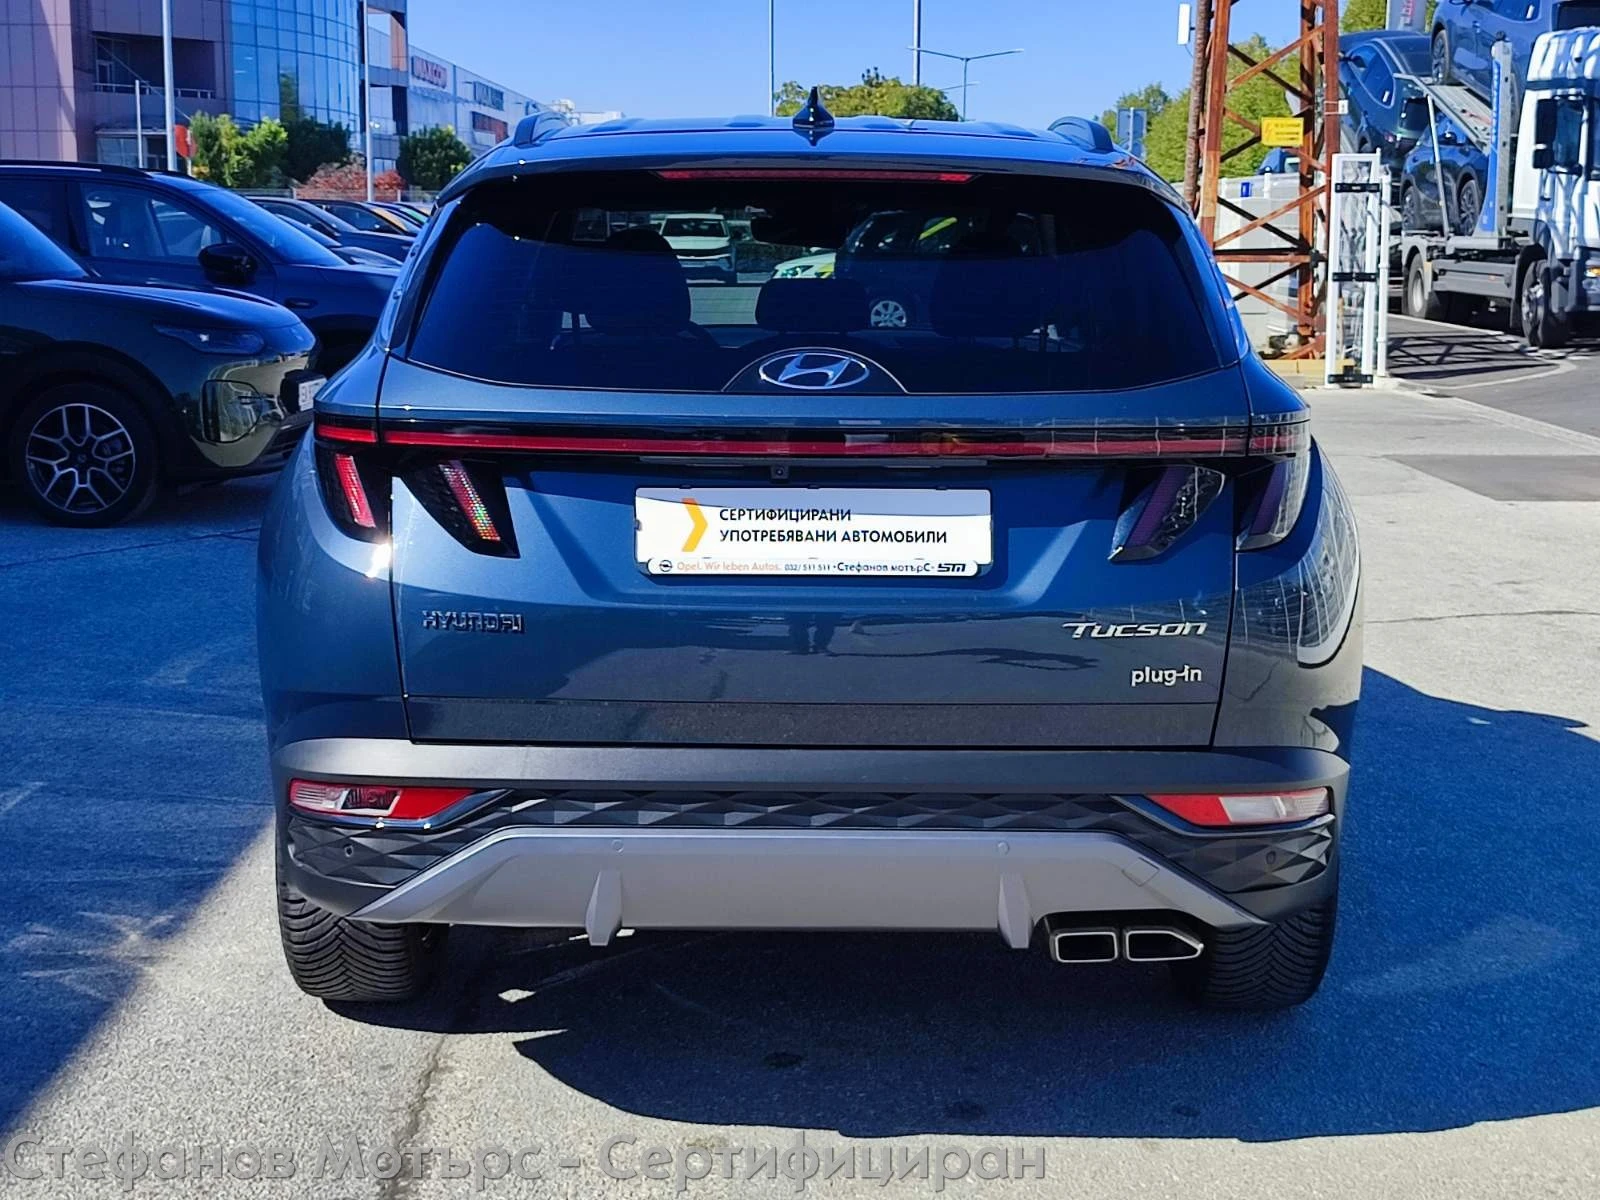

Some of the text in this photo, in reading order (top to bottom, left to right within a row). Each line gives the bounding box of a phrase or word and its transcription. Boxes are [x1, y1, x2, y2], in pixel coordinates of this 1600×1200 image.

[719, 507, 852, 523] СЕРТИФИЦИРАНИ
[719, 529, 948, 544] УПОТРЕБЯВАНИ АВТОМОБИЛИ
[704, 561, 721, 572] Wir
[723, 561, 749, 572] leben
[421, 609, 525, 634] HYUNDAI
[1131, 664, 1203, 688] plug-in
